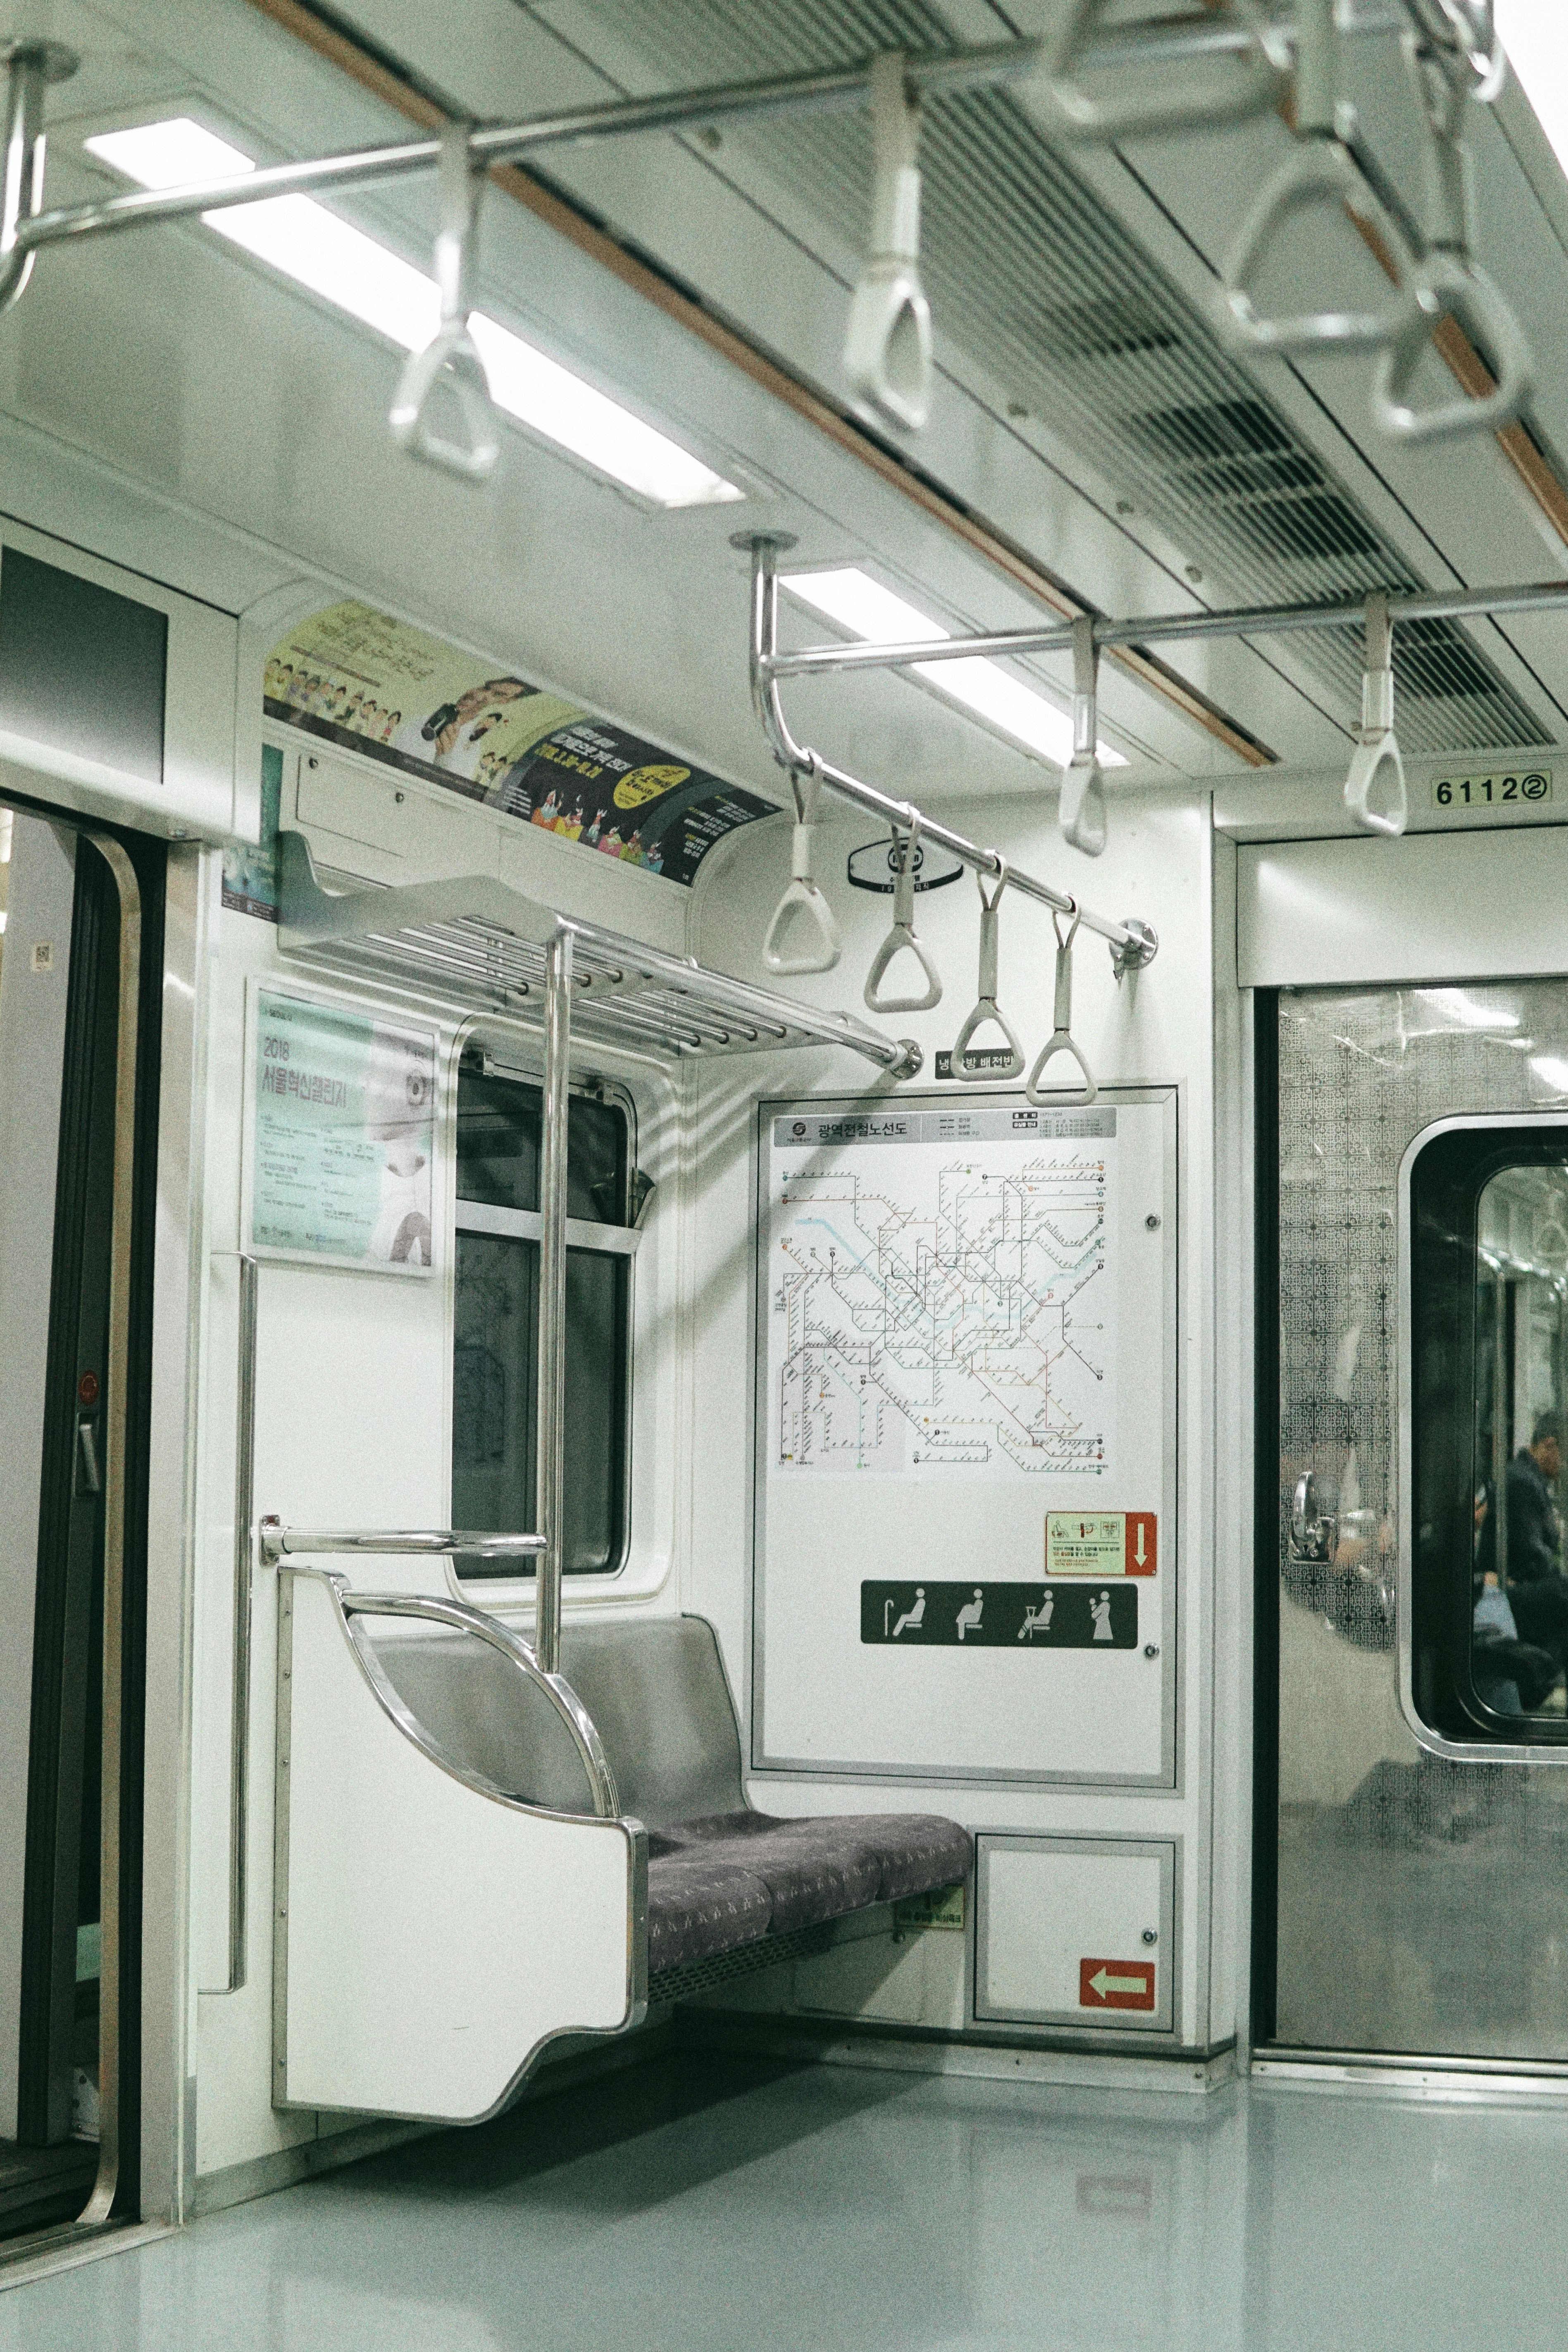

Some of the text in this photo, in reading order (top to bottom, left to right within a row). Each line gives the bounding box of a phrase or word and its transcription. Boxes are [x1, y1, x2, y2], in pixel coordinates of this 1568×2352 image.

[264, 1036, 290, 1062] 2018
[939, 1055, 1014, 1071] 냉방 배전반
[818, 1122, 908, 1138] 광역전철노선도
